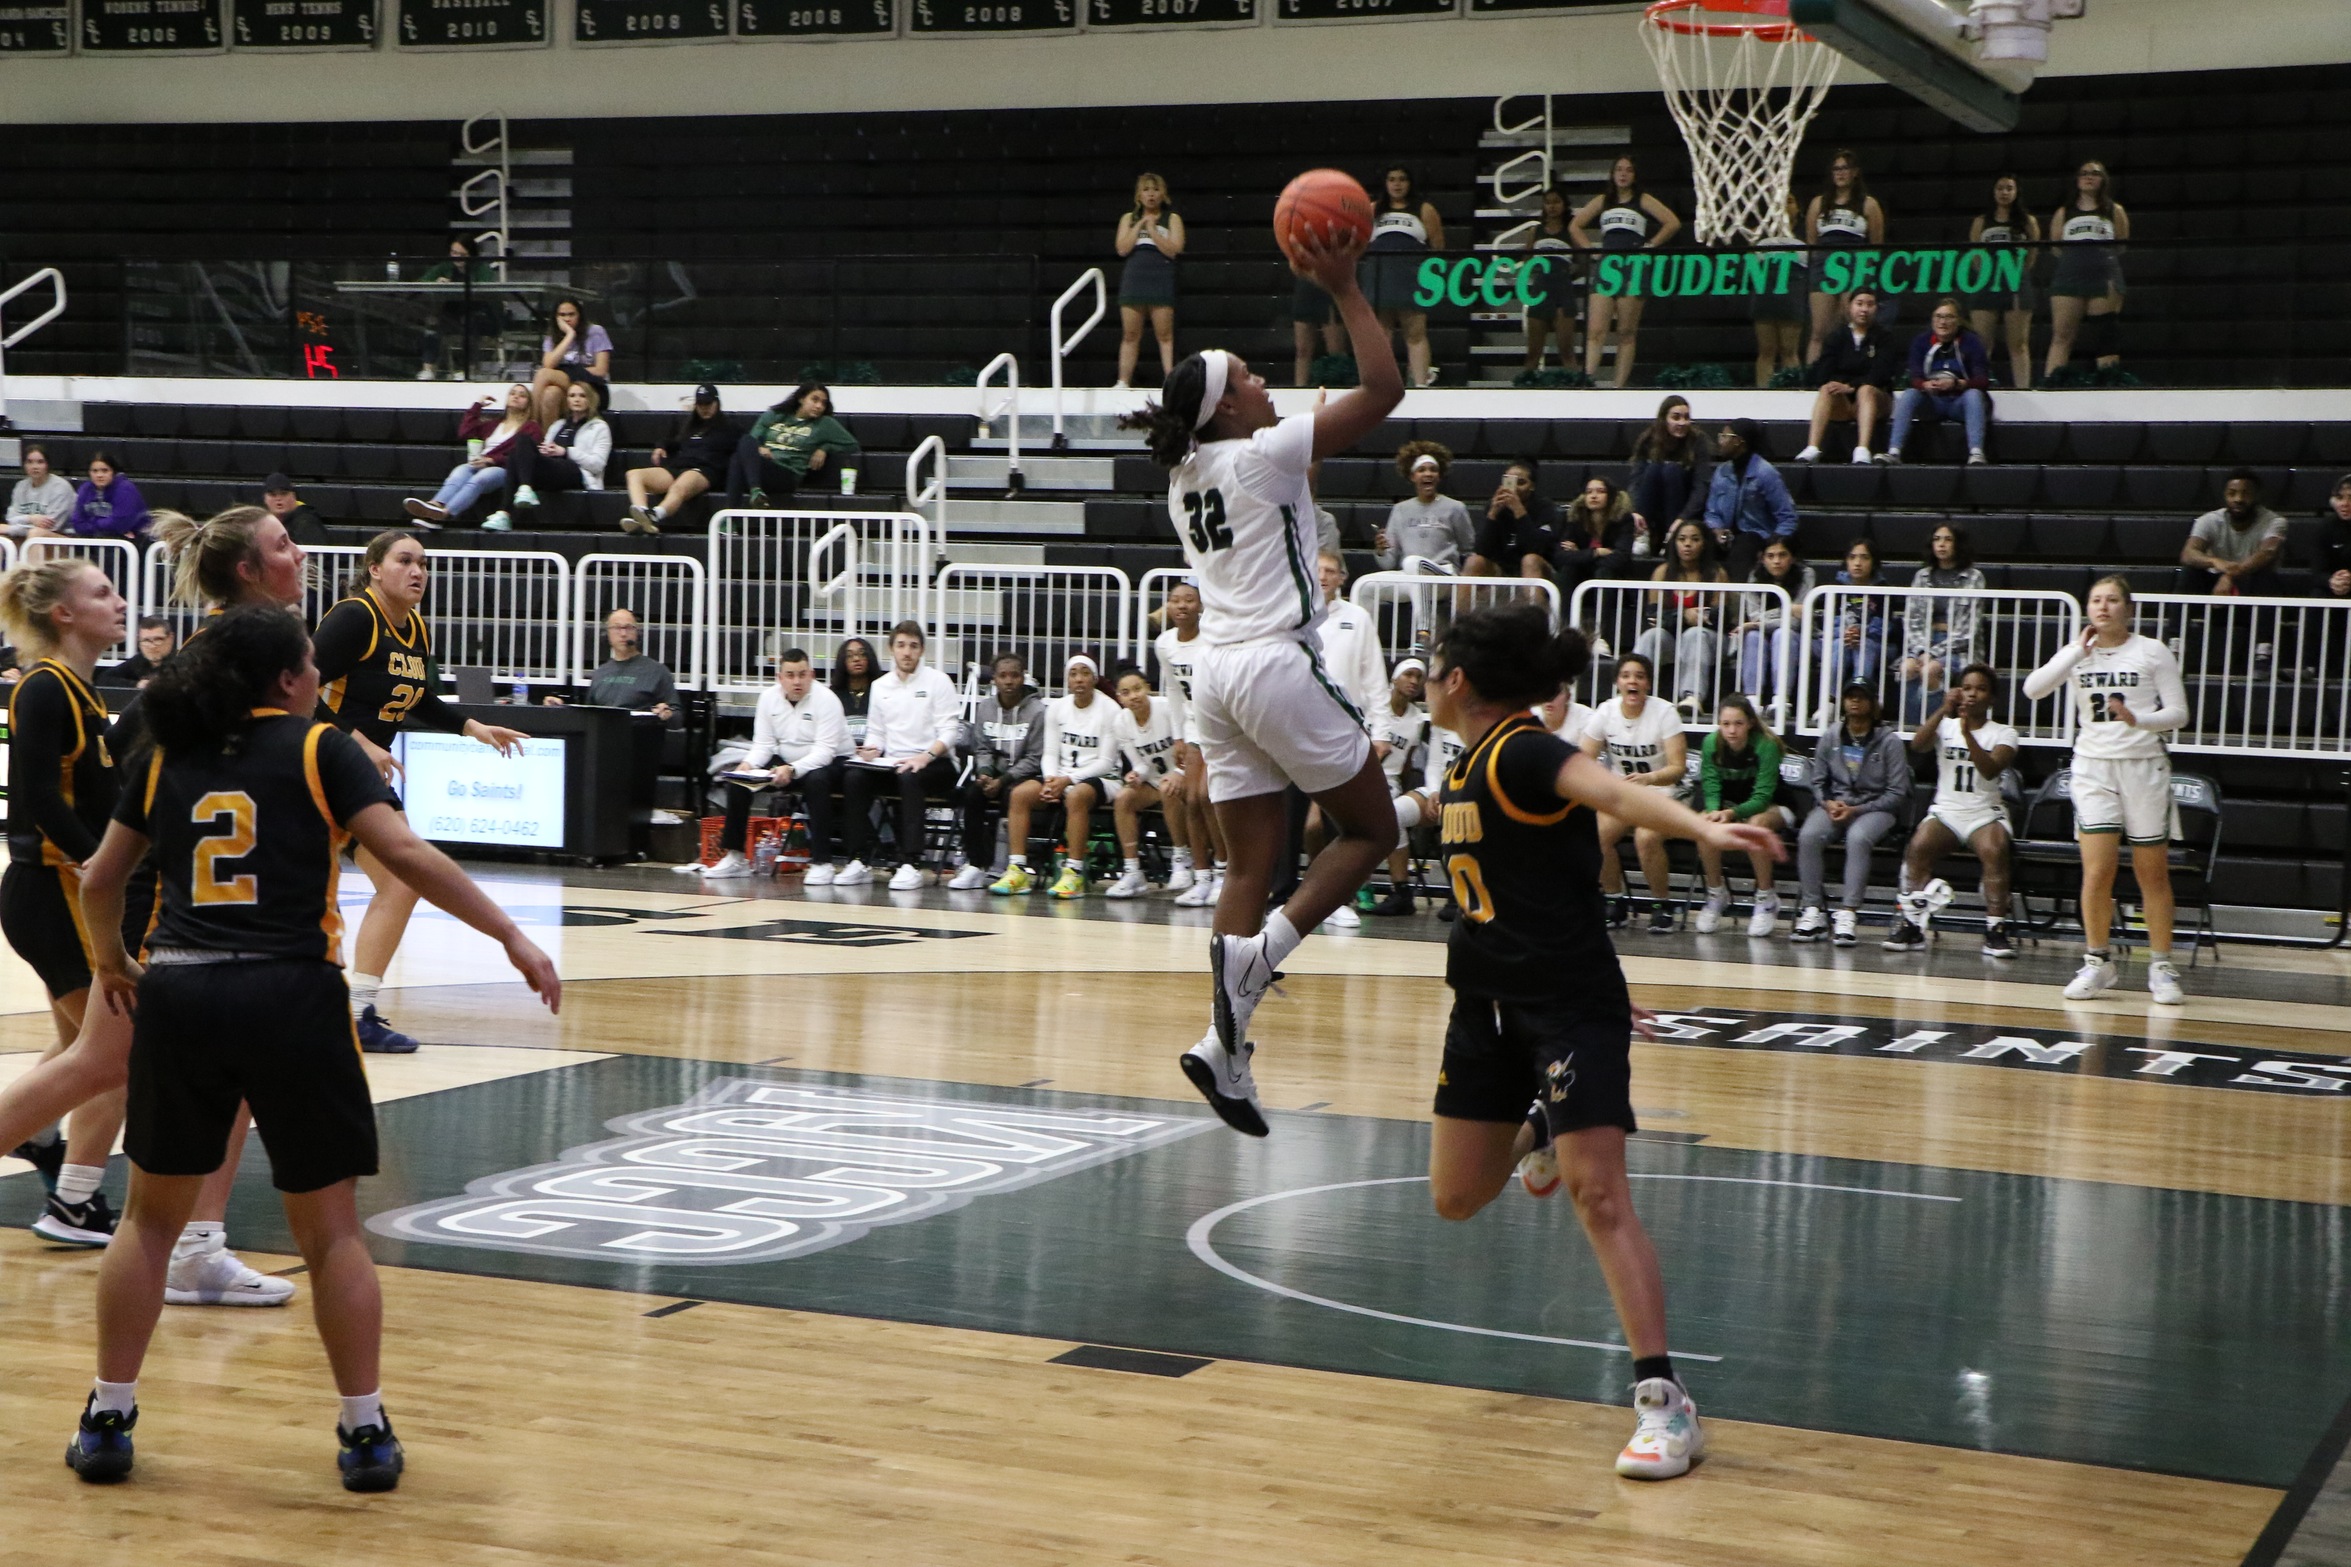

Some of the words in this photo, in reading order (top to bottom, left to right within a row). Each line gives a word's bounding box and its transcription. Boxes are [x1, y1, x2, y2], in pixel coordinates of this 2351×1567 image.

[626, 14, 681, 31] 2008
[789, 9, 842, 27] 2008
[964, 6, 1022, 23] 2008
[128, 27, 177, 43] 2006
[447, 21, 498, 38] 2010
[1413, 256, 1551, 307] SCCC
[1595, 252, 1799, 297] STUDENT
[1819, 248, 2028, 295] SECTION
[1183, 488, 1234, 554] 32
[2079, 671, 2139, 688] SEWARD
[1954, 765, 1975, 793] 11
[447, 780, 467, 797] Go
[472, 781, 524, 800] Saints!
[430, 816, 465, 835] (620)
[470, 818, 540, 837] 624-0462
[191, 790, 258, 906] 2
[1447, 854, 1496, 923] 0
[1632, 1013, 2351, 1091] SAINTS
